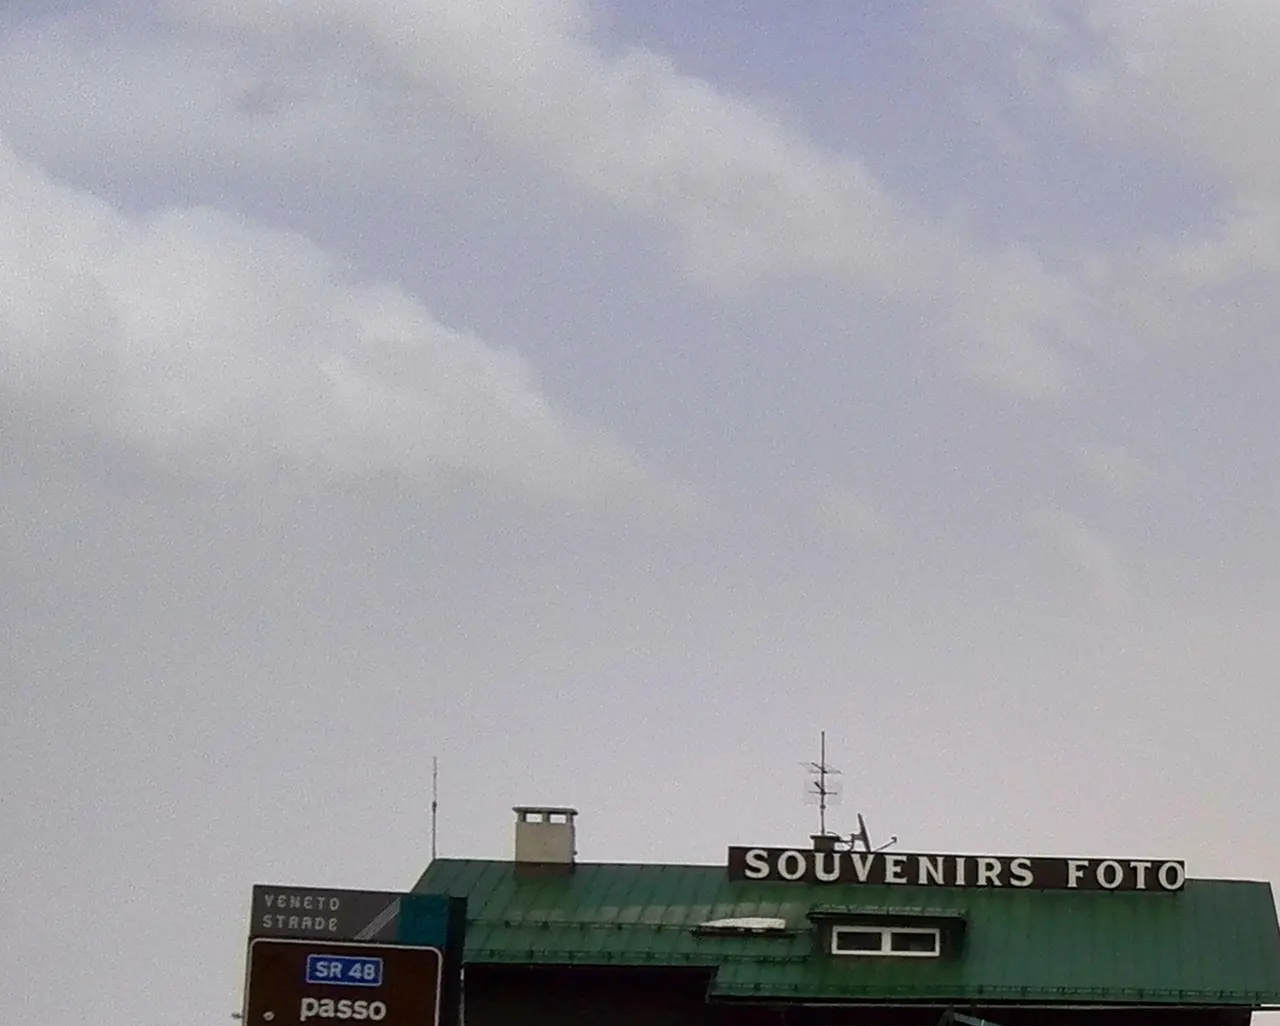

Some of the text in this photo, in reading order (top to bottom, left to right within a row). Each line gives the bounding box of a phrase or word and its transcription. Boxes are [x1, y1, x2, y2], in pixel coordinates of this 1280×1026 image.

[744, 848, 1186, 891] SOUVENIRS FOTO
[264, 894, 340, 911] VENETO
[263, 914, 338, 932] STRADE
[315, 961, 376, 980] SR 48
[300, 997, 387, 1021] passo
